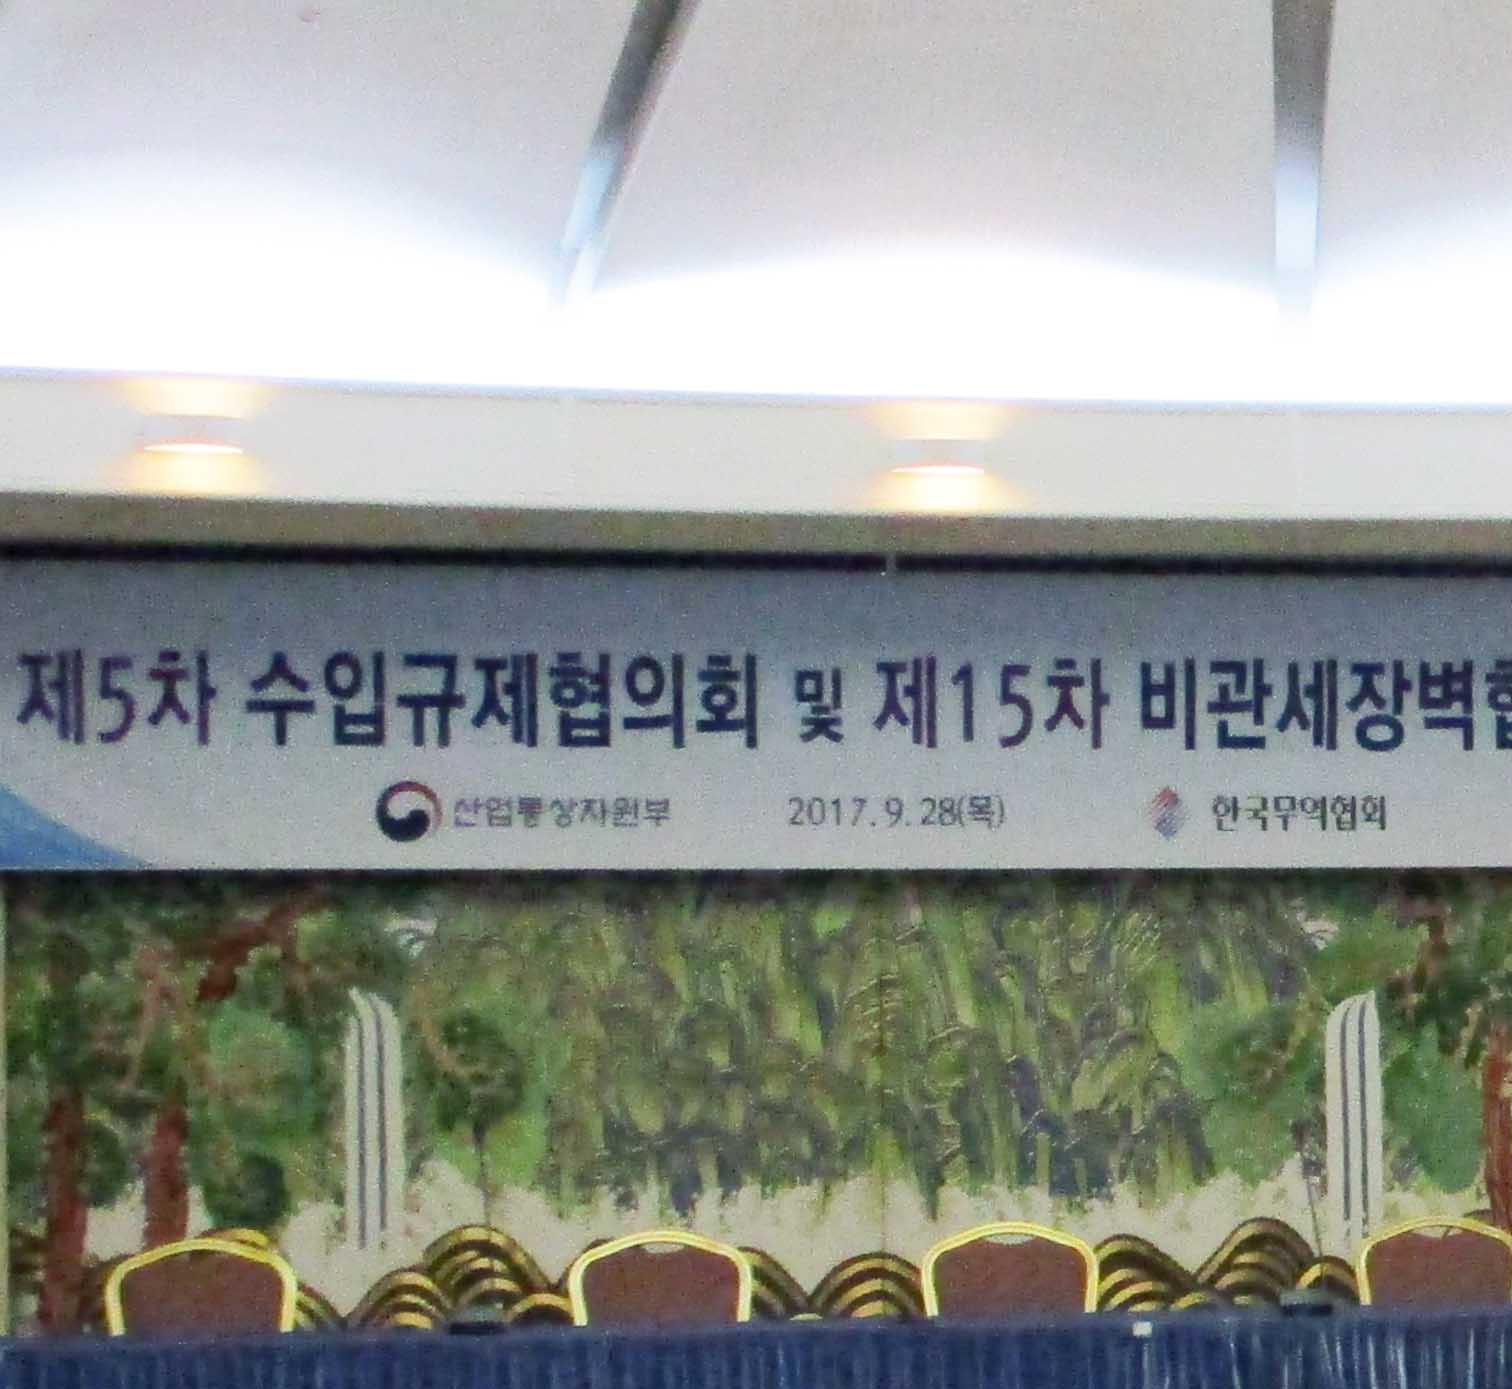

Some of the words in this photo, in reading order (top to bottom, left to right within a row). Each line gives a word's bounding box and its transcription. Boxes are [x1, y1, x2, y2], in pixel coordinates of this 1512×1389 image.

[15, 648, 217, 747] 제5차
[244, 648, 760, 750] 수입규제협의회
[793, 667, 844, 745] 및
[873, 655, 1111, 750] 제15차
[453, 796, 671, 828] 산업통상자원부
[1211, 795, 1387, 832] 한국무역협회
